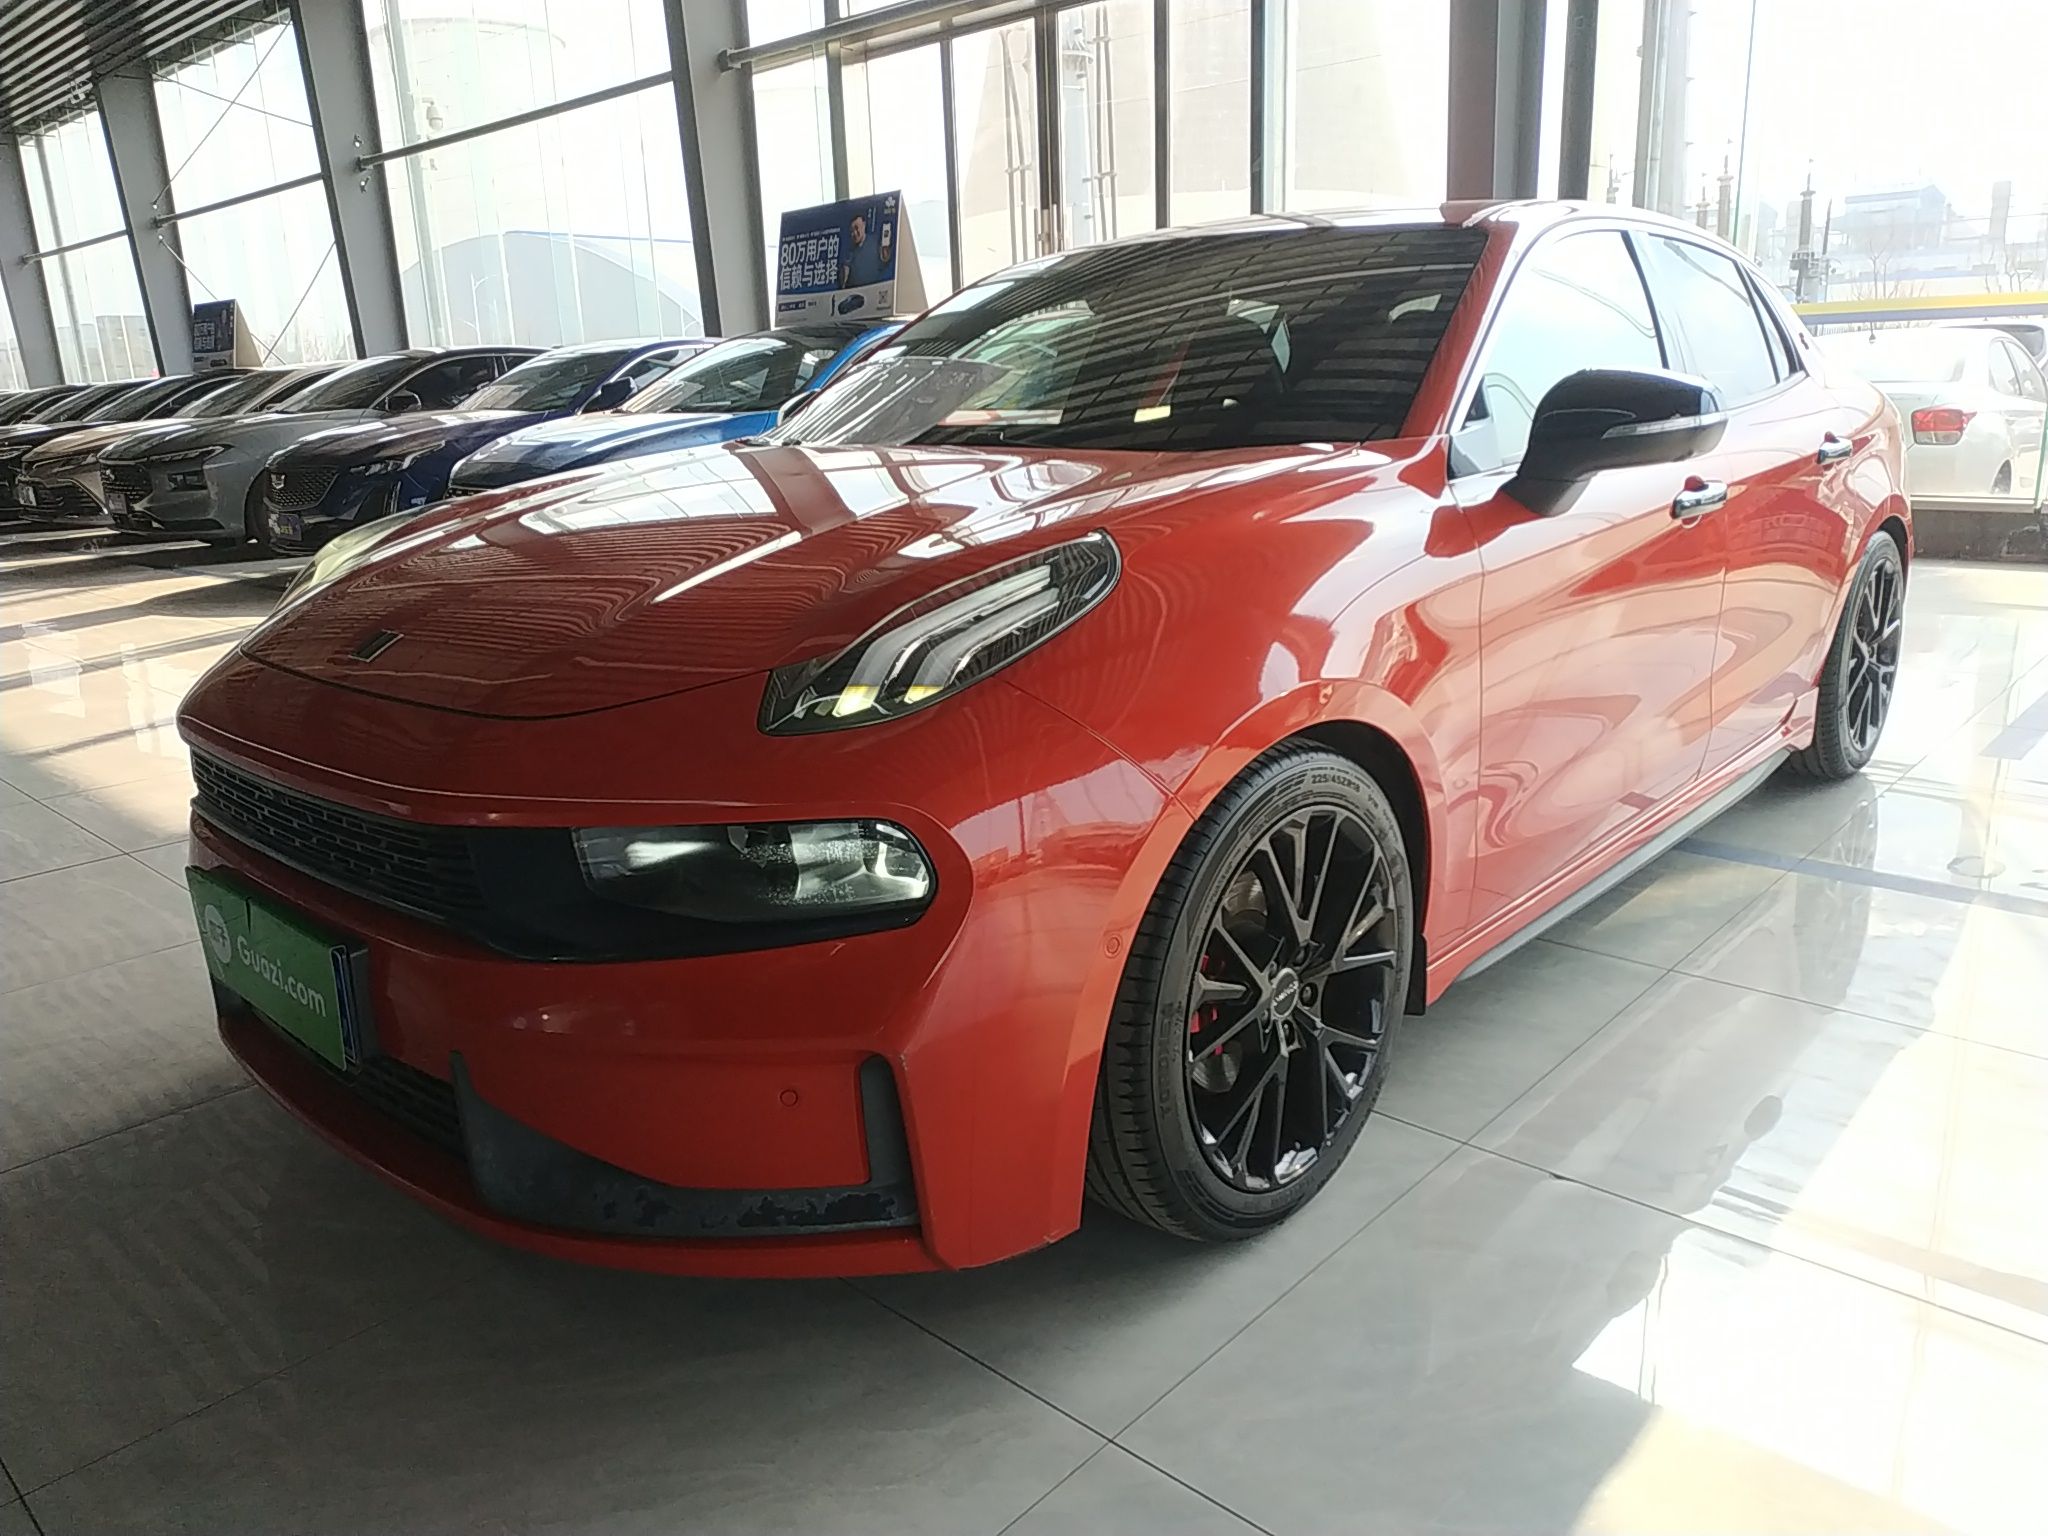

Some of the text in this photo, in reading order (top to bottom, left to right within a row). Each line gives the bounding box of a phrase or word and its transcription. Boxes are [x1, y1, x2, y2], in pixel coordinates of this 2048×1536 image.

[781, 234, 840, 267] 80万用户的
[780, 259, 838, 290] 信赖与选择
[237, 935, 327, 1018] Guazi.com
